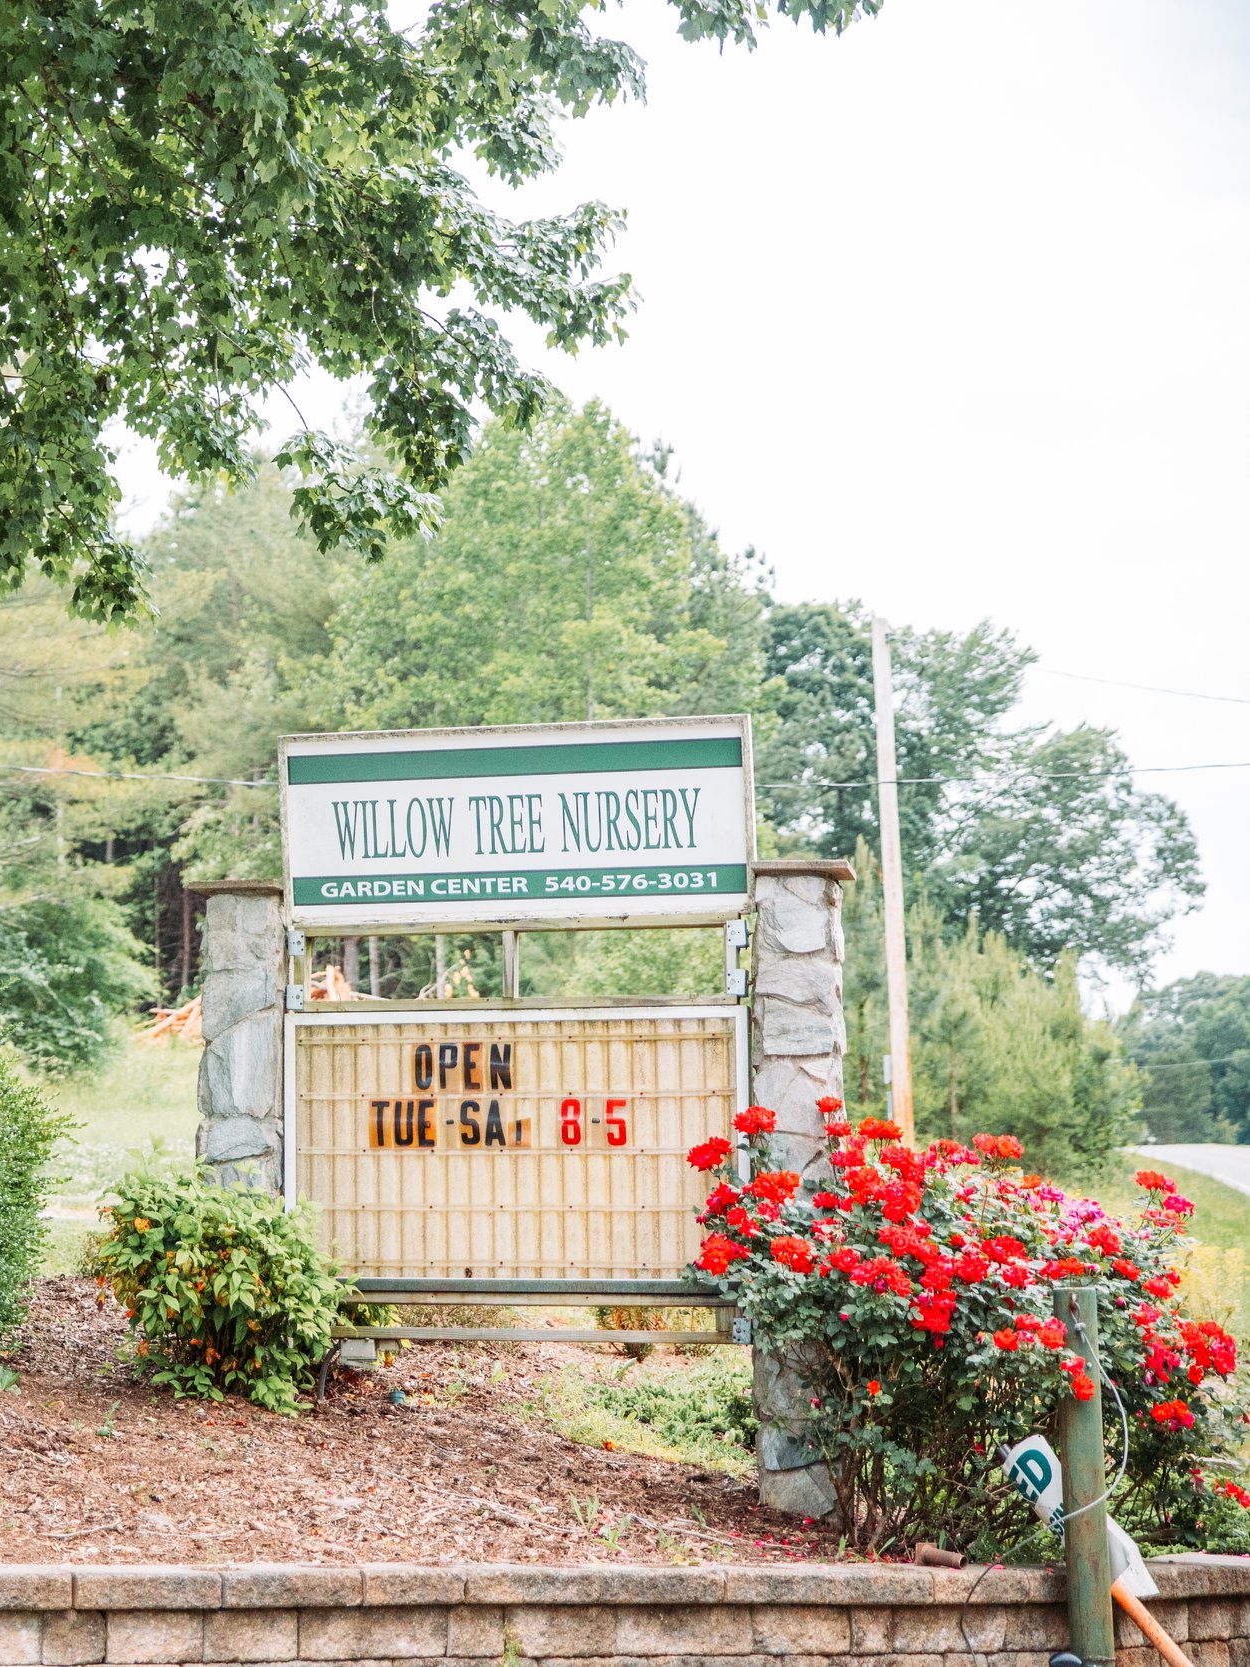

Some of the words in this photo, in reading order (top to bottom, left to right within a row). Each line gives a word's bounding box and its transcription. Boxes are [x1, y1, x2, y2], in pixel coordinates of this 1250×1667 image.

[331, 797, 455, 861] WILLOW
[468, 793, 546, 856] TREE
[557, 787, 701, 854] NURSERY
[320, 879, 425, 899] GARDEN
[430, 877, 529, 896] CENTER
[544, 871, 718, 893] 540-576-3031
[414, 1042, 513, 1091] OPEN
